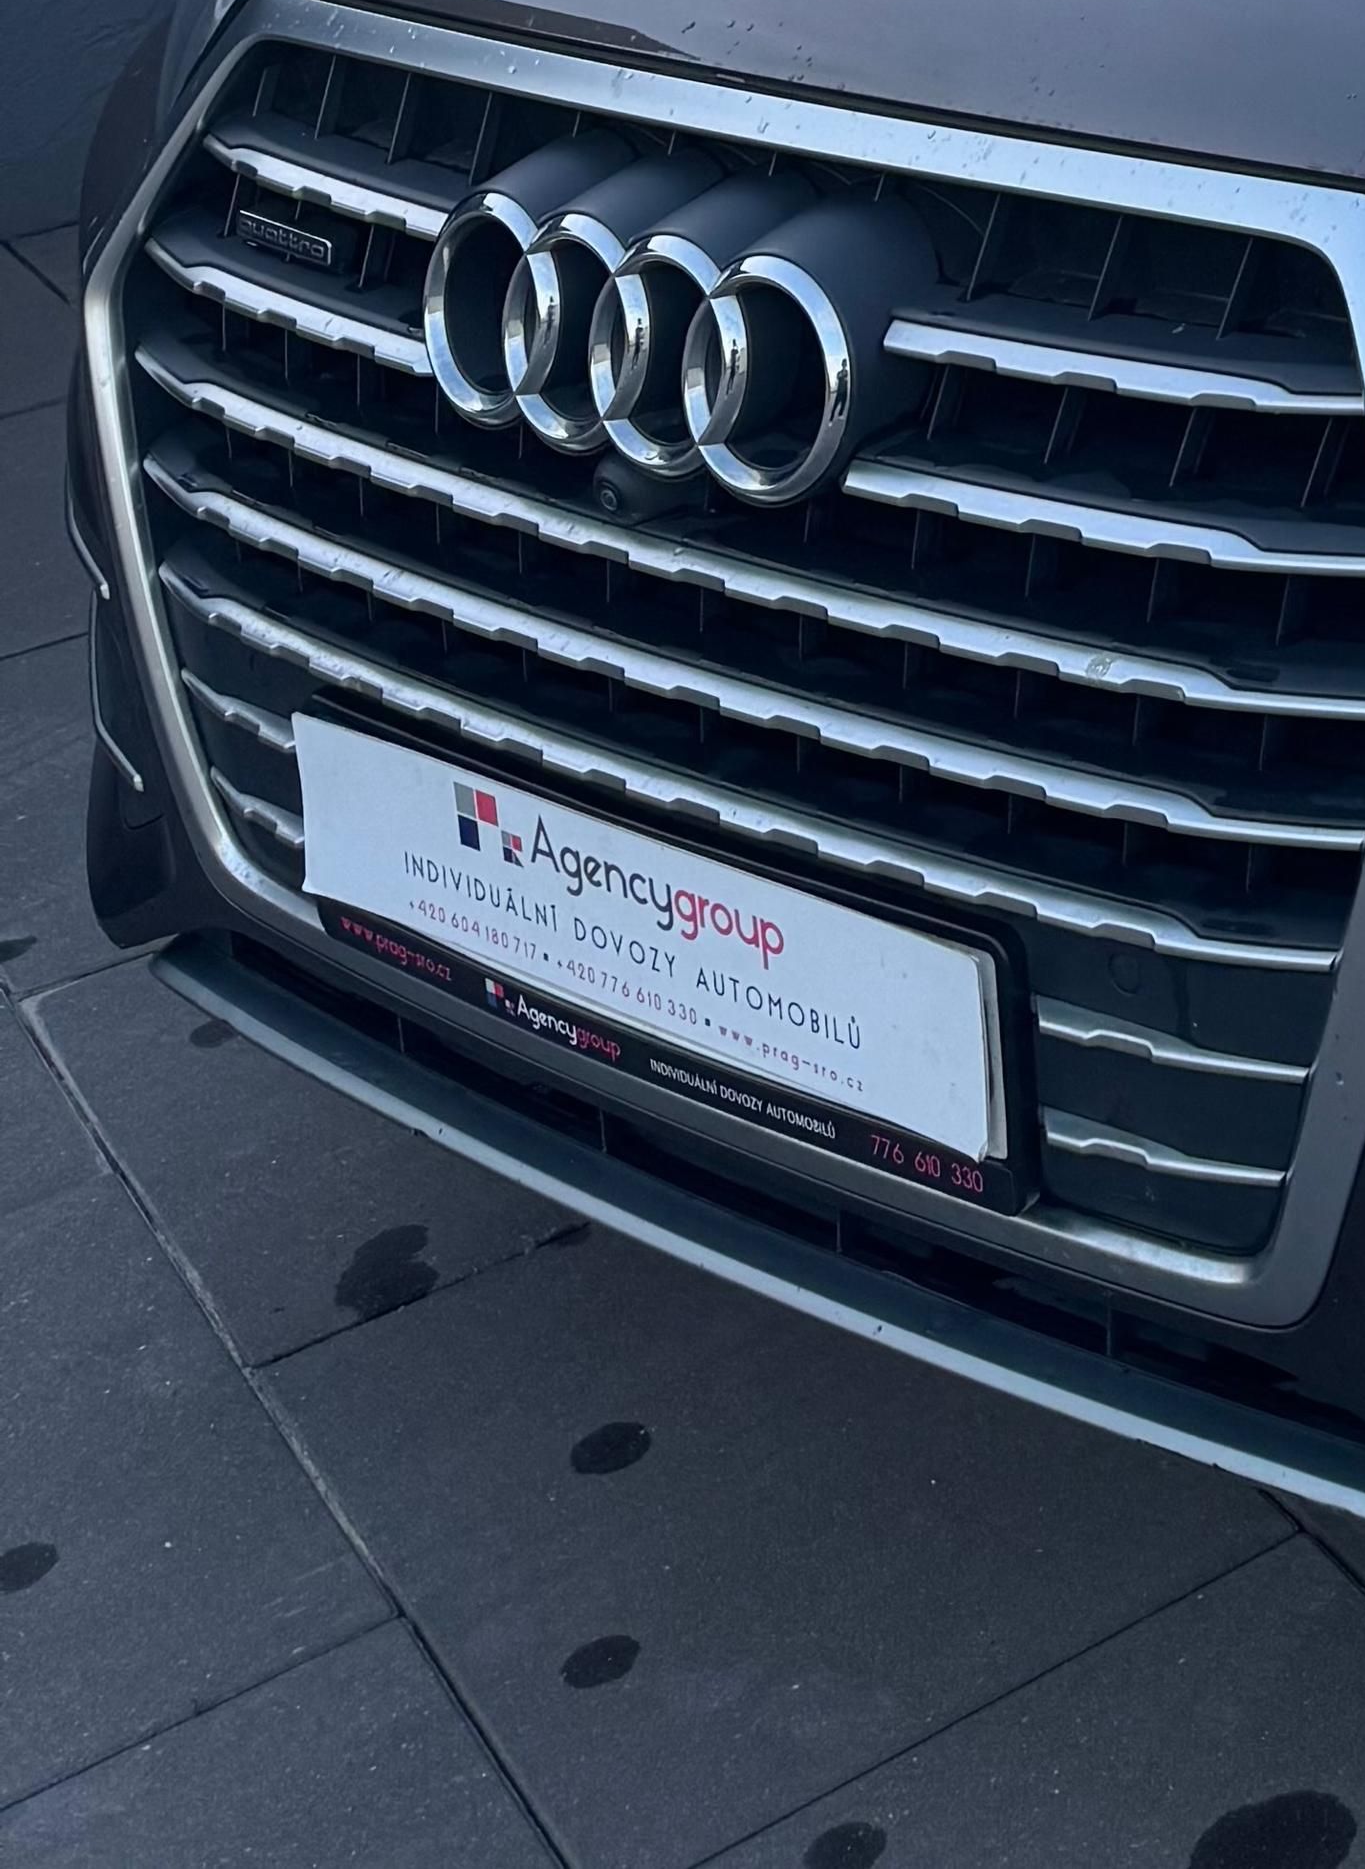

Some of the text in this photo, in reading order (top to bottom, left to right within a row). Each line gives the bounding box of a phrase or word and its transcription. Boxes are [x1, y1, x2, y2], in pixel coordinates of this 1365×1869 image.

[403, 851, 861, 1049] INDIVIDUÁLNÍ DOVOZY AUTOMOBILŮ
[530, 814, 785, 970] Agencygroup
[517, 994, 621, 1062] Agencygroup
[719, 1085, 763, 1113] DOVOZY
[870, 1133, 905, 1164] 776
[914, 1150, 941, 1178] 610
[951, 1162, 984, 1194] 330
[718, 1024, 863, 1091] www.prag-sro.cz
